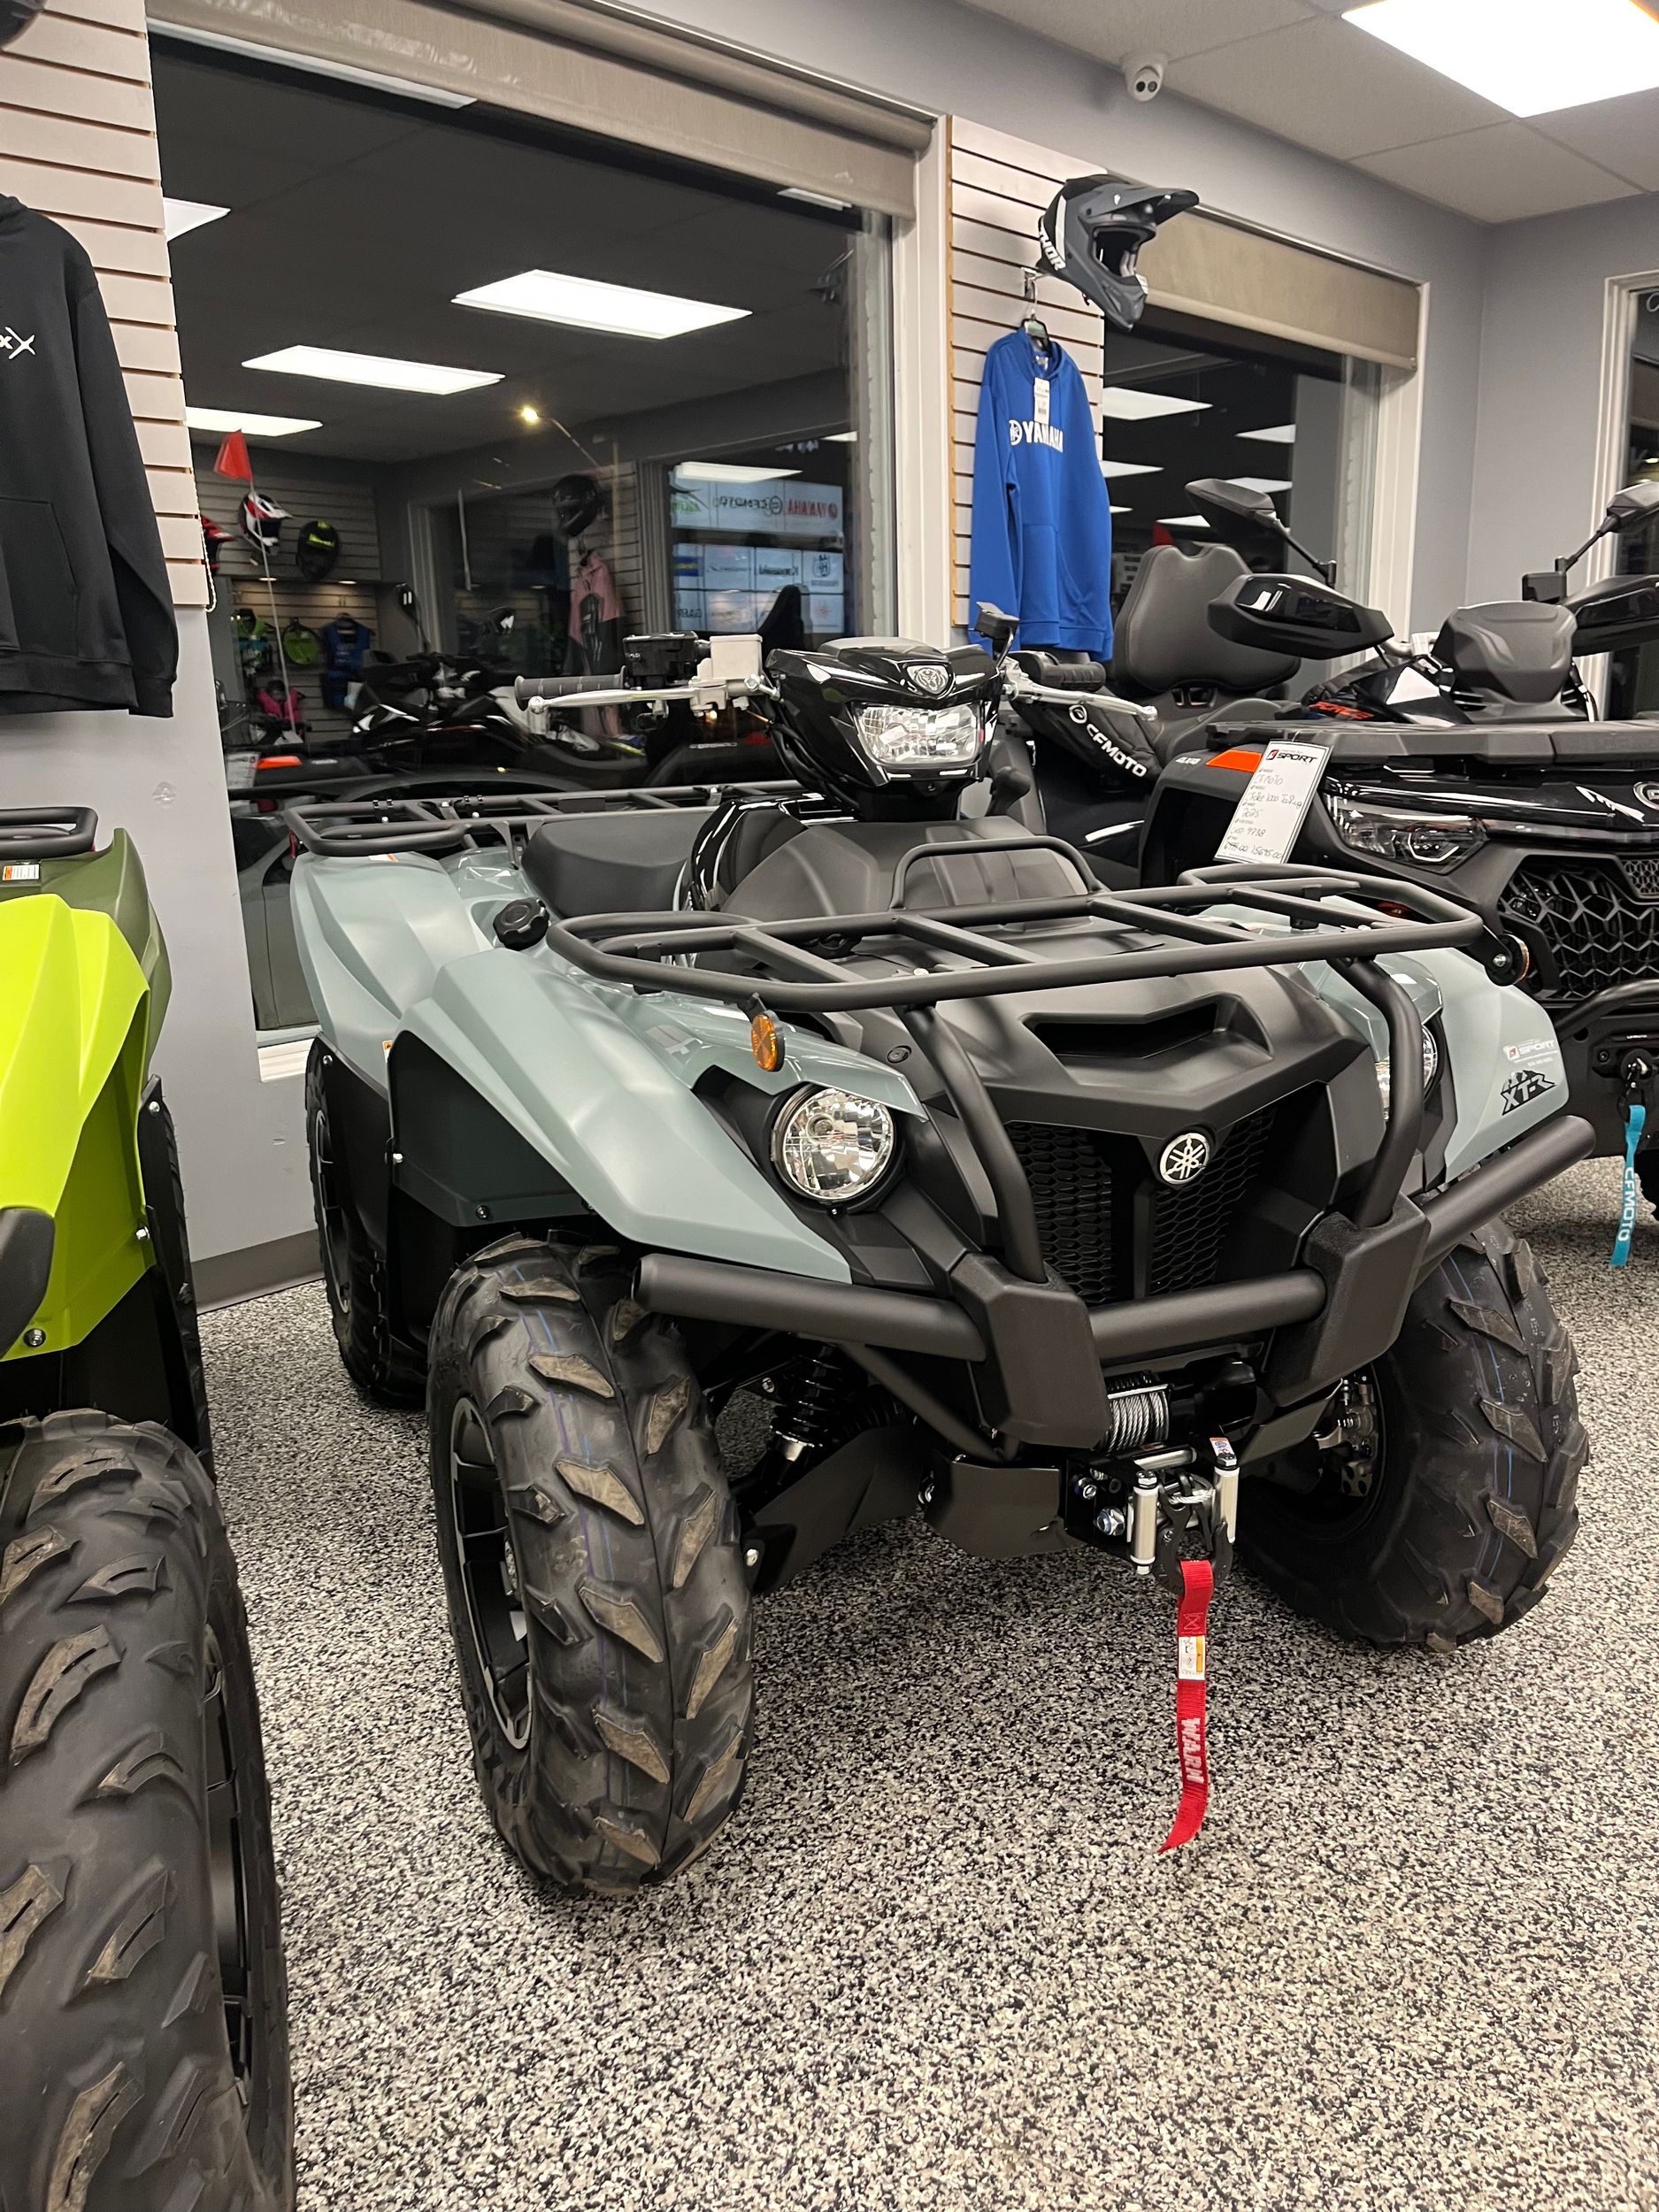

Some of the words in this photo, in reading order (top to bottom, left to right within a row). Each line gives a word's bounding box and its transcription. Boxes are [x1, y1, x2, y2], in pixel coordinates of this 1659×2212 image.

[1023, 420, 1064, 453] YAMAHA
[1087, 723, 1148, 777] CFMOTO
[1277, 752, 1317, 764] SPORT
[1617, 1167, 1635, 1242] CFMOTO
[1182, 1717, 1205, 1784] WARN
